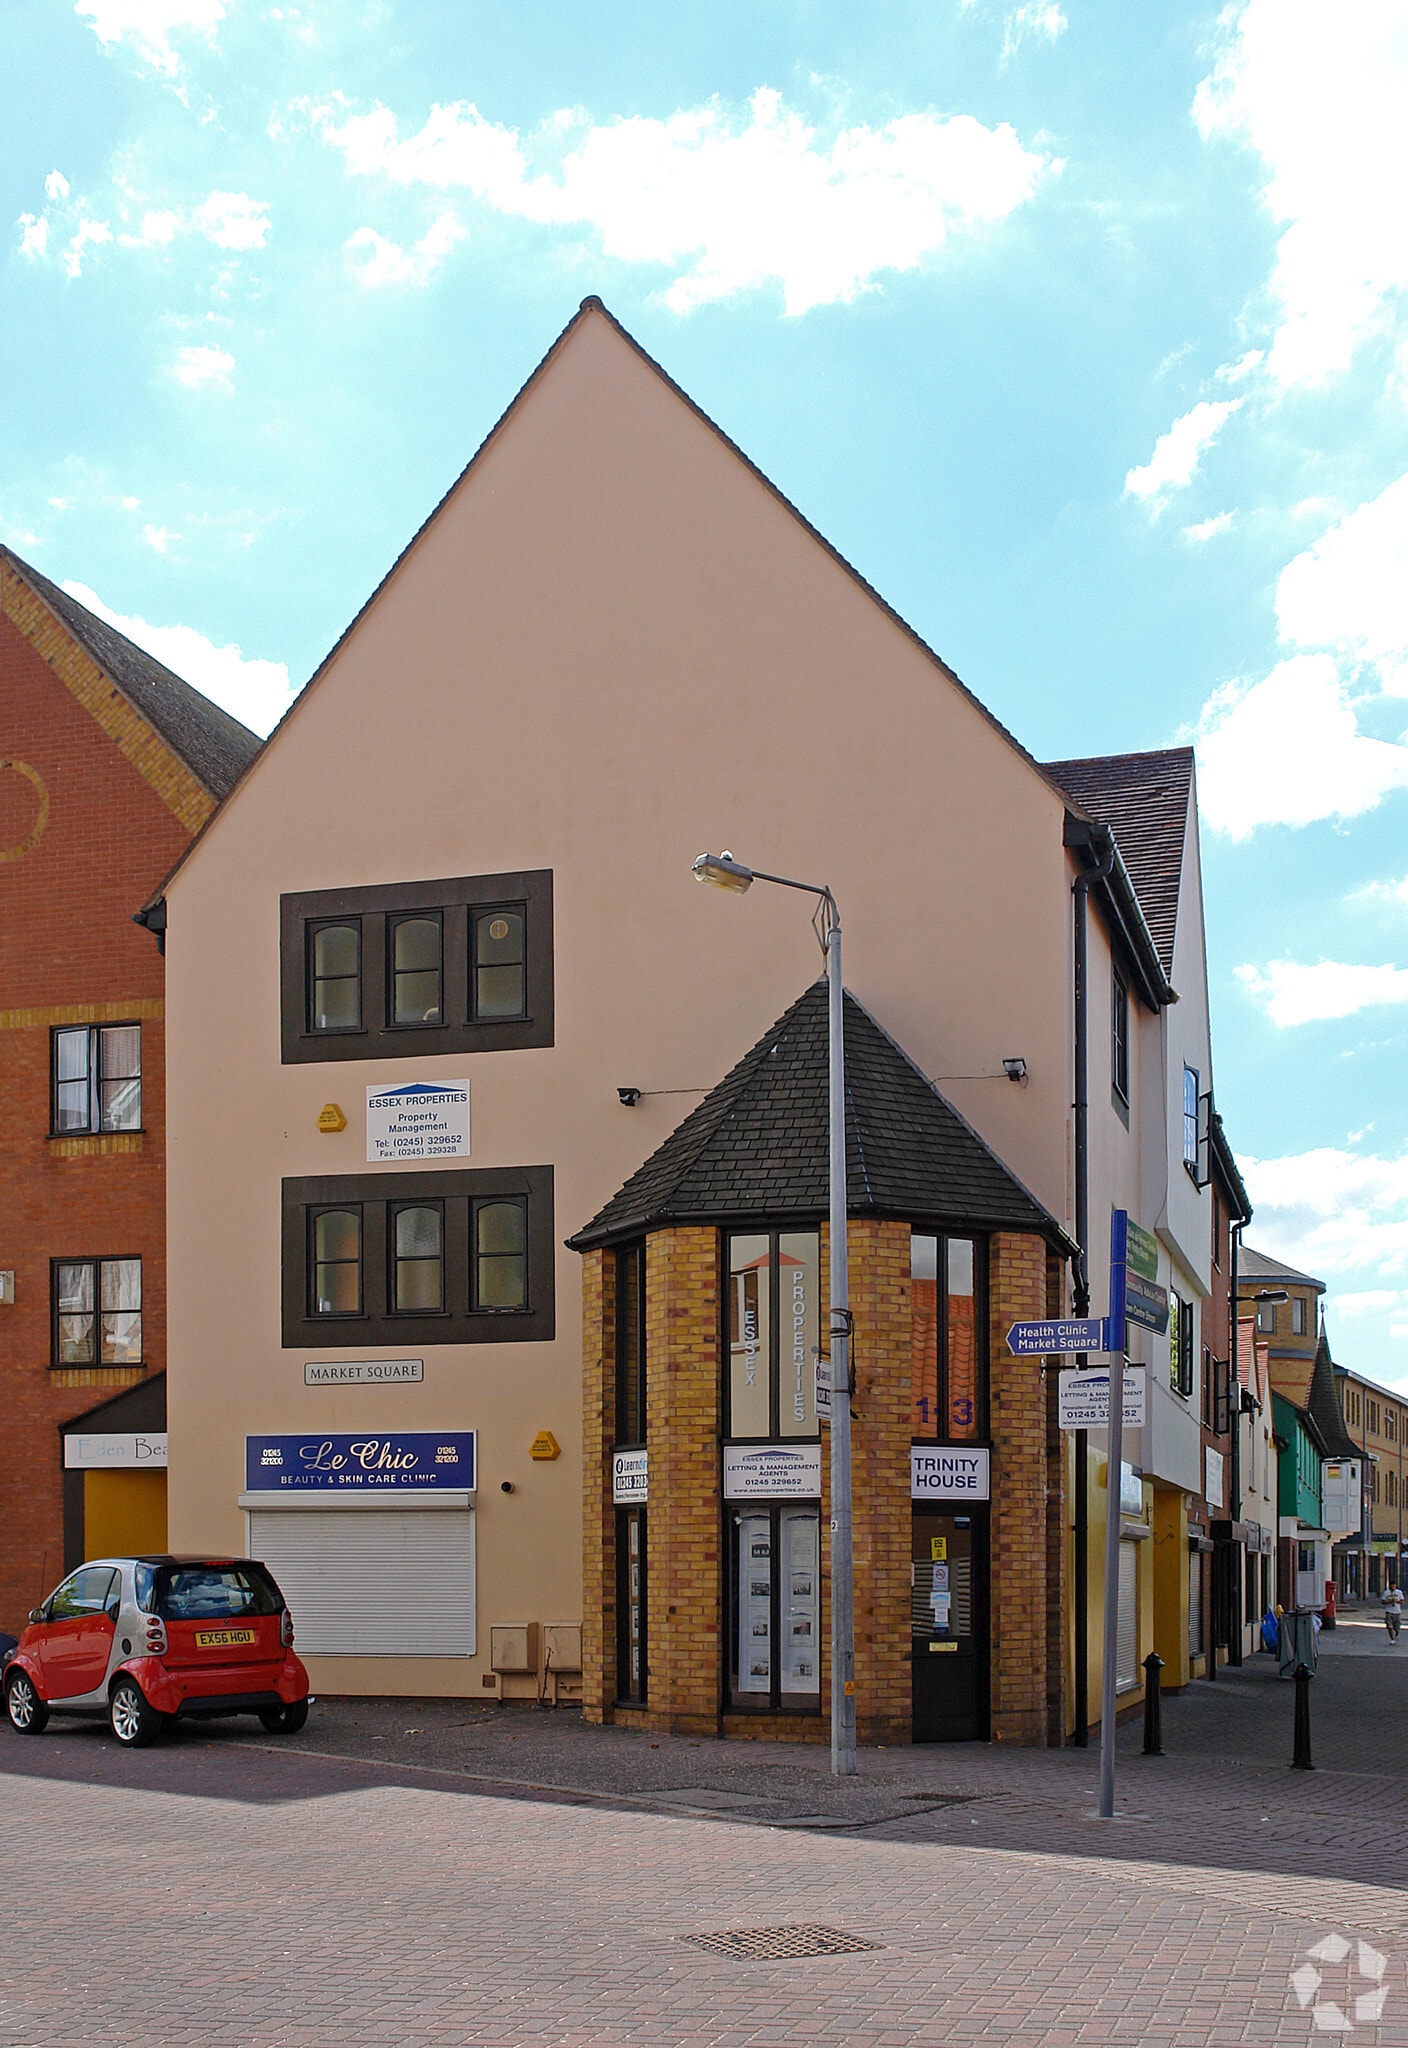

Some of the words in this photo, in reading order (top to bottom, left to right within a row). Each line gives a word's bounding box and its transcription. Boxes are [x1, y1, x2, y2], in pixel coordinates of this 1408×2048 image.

[369, 1097, 401, 1108] ESSEX
[406, 1093, 467, 1105] PROPERTIES
[398, 1112, 438, 1123] Property
[388, 1122, 448, 1134] Management
[375, 1139, 389, 1148] Tel:
[393, 1136, 423, 1148] (0245)
[427, 1135, 462, 1145] 329652
[379, 1149, 395, 1158] Fax:
[398, 1147, 424, 1157] (0245)
[427, 1146, 457, 1155] 329328
[1018, 1326, 1054, 1338] Health
[1058, 1325, 1088, 1336] Clinic
[744, 1310, 756, 1386] ESSEX
[792, 1271, 806, 1422] PROPERTIES
[1018, 1339, 1056, 1349] Market
[1060, 1338, 1098, 1348] Square
[310, 1367, 363, 1380] MARKET
[367, 1366, 418, 1378] SQUARE
[1100, 1410, 1137, 1418] 3252
[78, 1439, 124, 1460] Eden
[262, 1448, 281, 1456] 01245
[300, 1441, 348, 1470] Le
[350, 1440, 418, 1470] Chic
[437, 1446, 456, 1454] 01245
[260, 1456, 284, 1466] 321200
[434, 1454, 458, 1464] 321200
[914, 1458, 979, 1472] TRINITY
[280, 1475, 323, 1484] BEAUTY
[328, 1475, 334, 1484] &
[338, 1474, 363, 1484] SKIN
[367, 1474, 396, 1483] CARE
[401, 1474, 437, 1483] CLINIC
[916, 1474, 978, 1488] HOUSE
[200, 1632, 228, 1644] EX56
[230, 1632, 250, 1642] HGU
